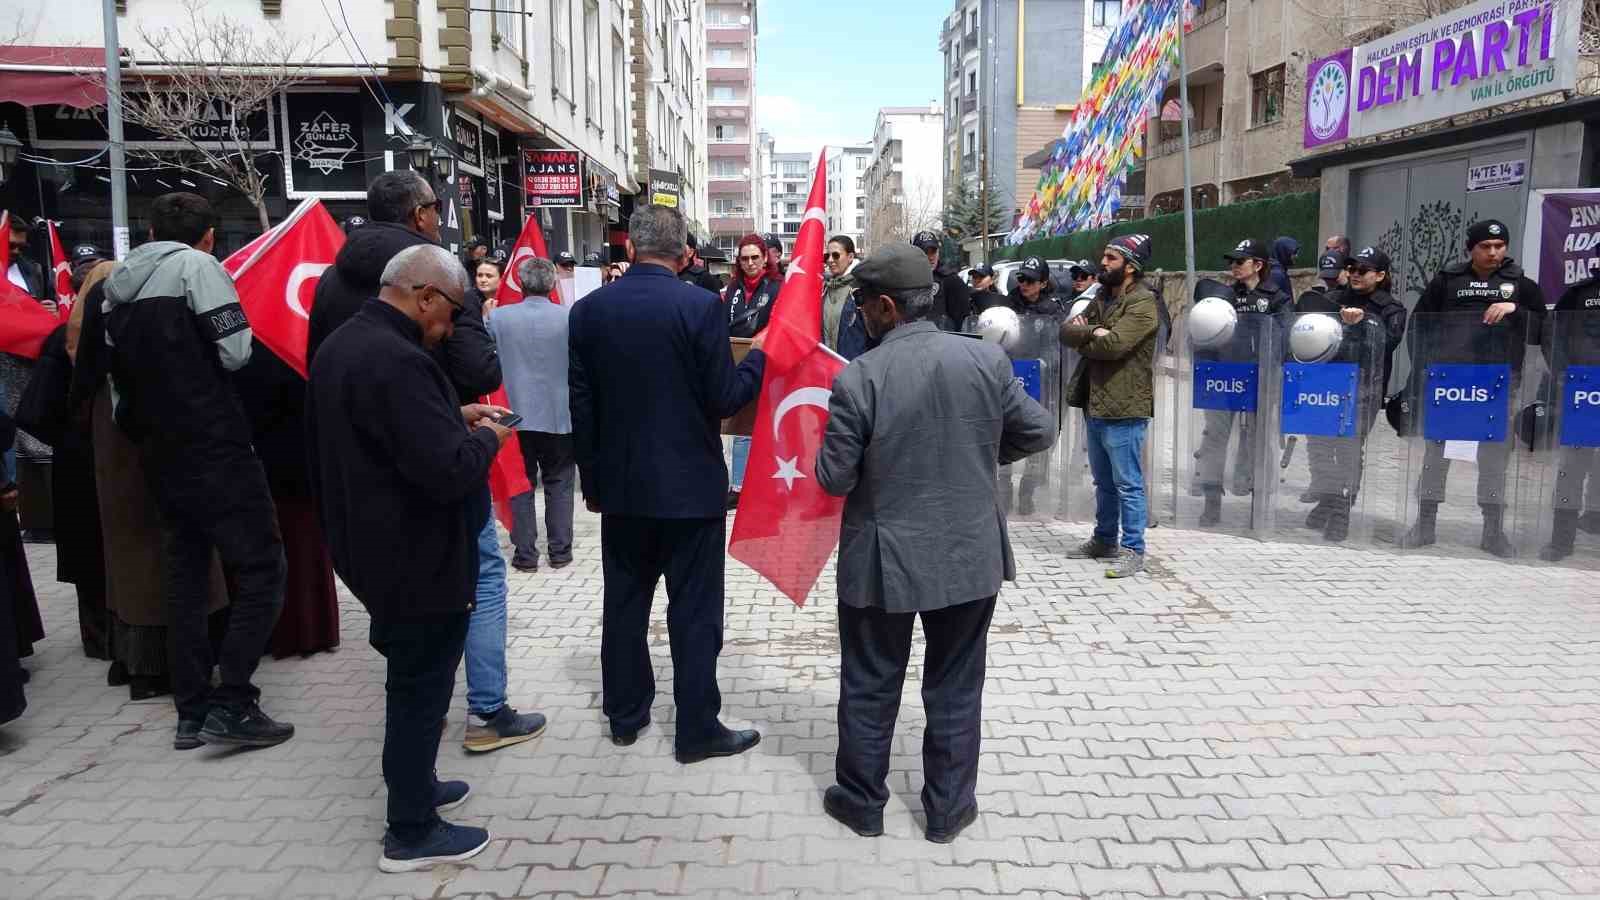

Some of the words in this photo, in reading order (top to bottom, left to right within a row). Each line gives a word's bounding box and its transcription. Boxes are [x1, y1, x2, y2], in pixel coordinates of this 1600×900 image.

[1366, 41, 1408, 64] HALKLARIN
[1440, 22, 1452, 38] VE
[1357, 47, 1423, 112] DEM
[1431, 2, 1553, 92] PARTİ
[1471, 84, 1492, 102] VAN
[1494, 80, 1504, 97] İL
[1506, 65, 1555, 93] ÖRGÜTÜ
[300, 121, 351, 133] ZAFER
[529, 163, 576, 173] AJANS
[1499, 162, 1512, 176] 14
[1206, 377, 1244, 393] POLİS
[1298, 390, 1340, 406] POLİS
[1434, 385, 1489, 402] POLİS
